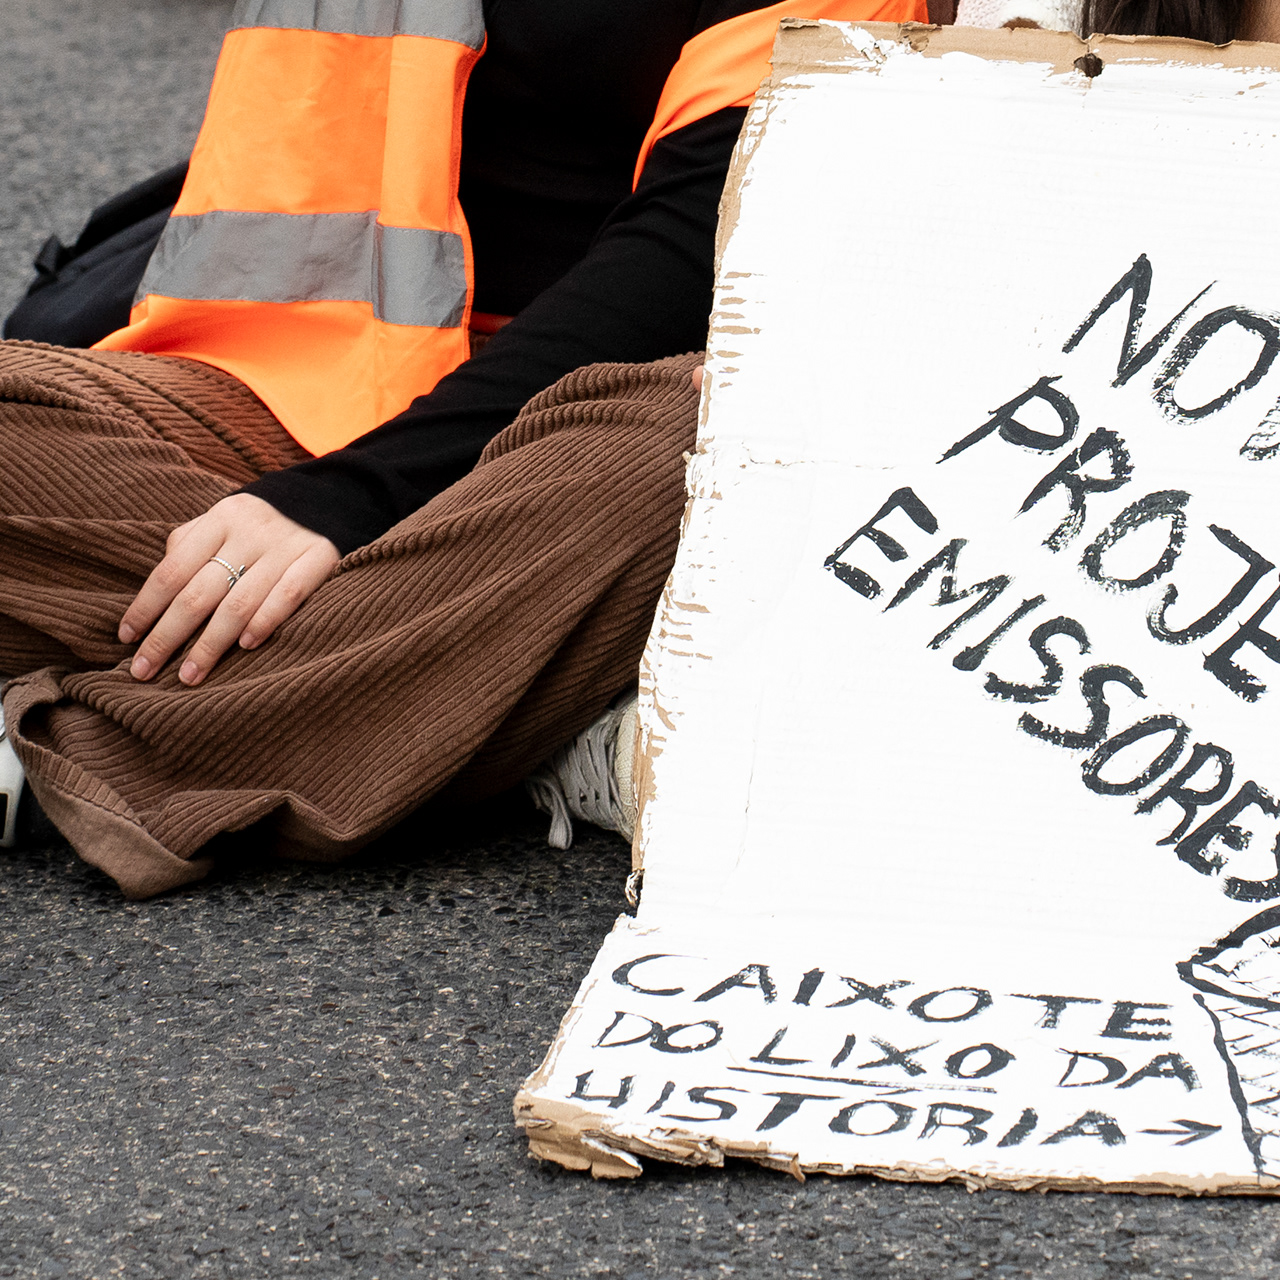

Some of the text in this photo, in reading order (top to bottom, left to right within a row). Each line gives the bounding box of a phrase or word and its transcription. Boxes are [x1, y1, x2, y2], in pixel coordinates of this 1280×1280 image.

[612, 953, 1173, 1042] CAIXOTE
[591, 1011, 1200, 1093] DO LIXO DA
